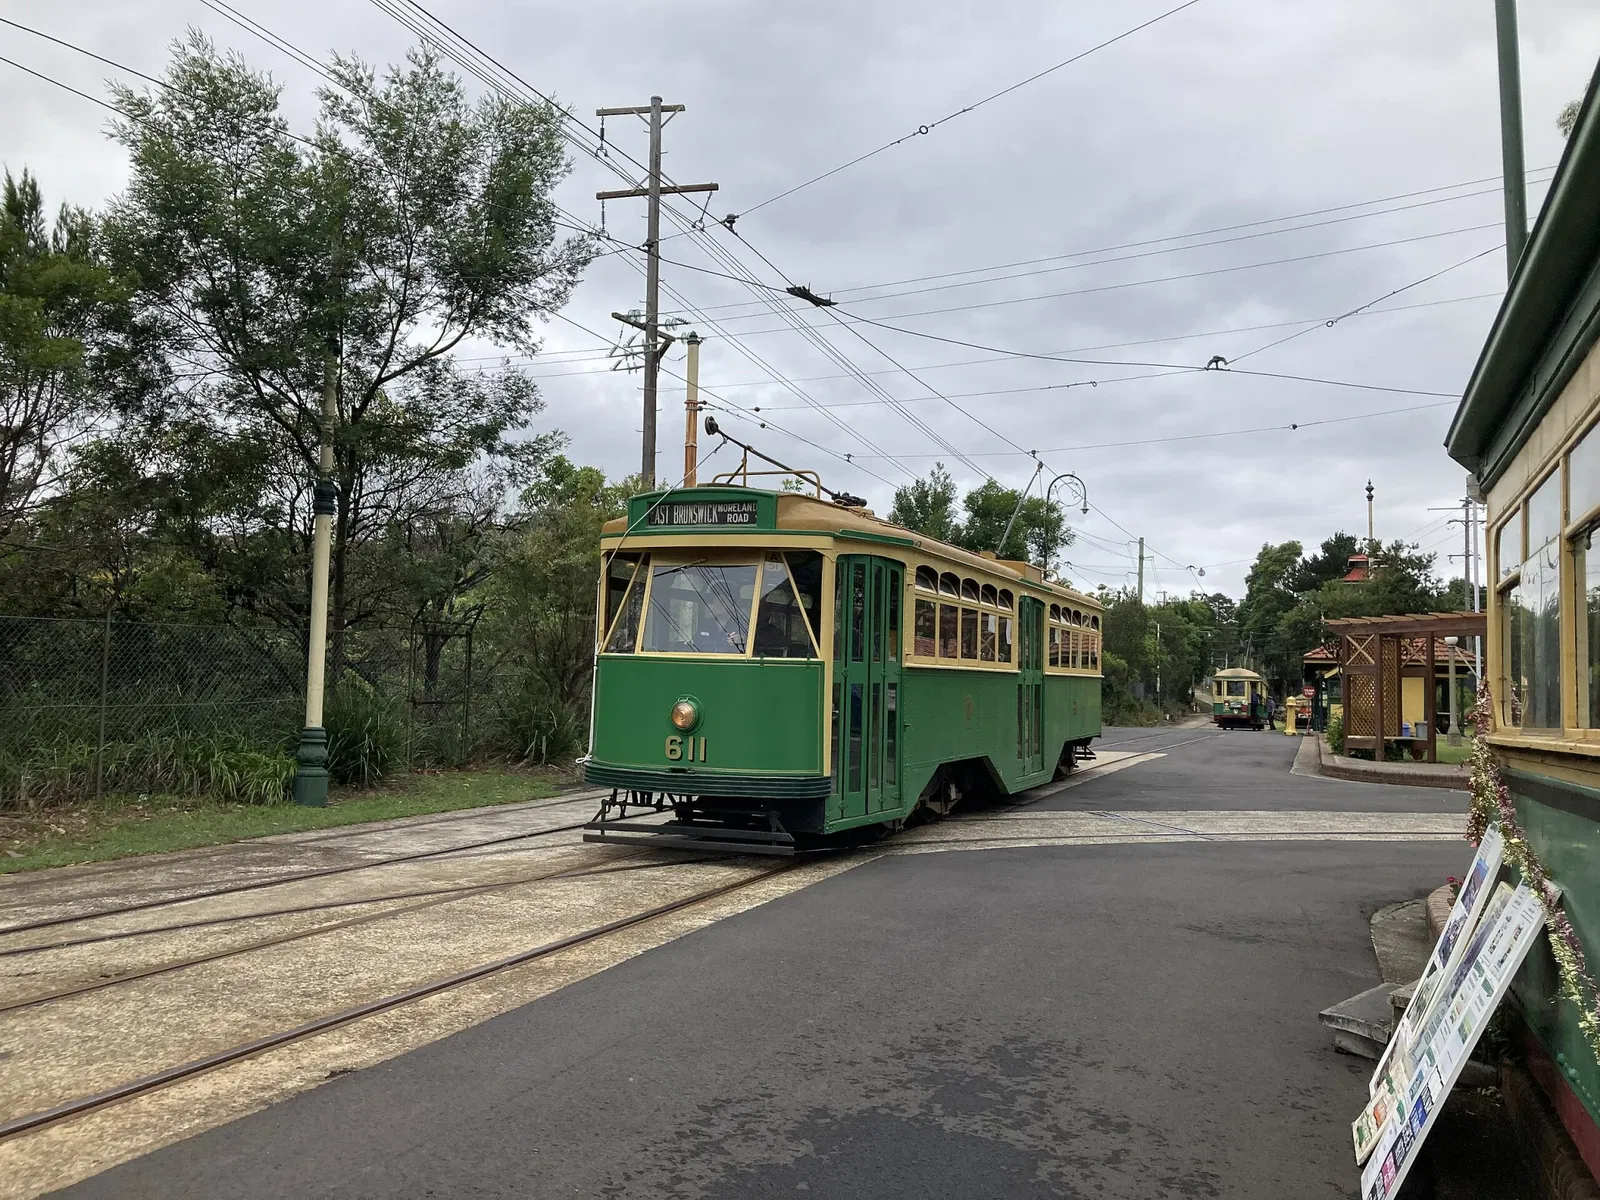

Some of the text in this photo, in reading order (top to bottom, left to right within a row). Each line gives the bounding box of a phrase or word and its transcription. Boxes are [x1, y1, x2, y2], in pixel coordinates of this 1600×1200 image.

[650, 503, 718, 525] AST BRUNSWICK
[717, 502, 757, 512] MORELAND
[726, 513, 749, 523] ROAD
[665, 735, 707, 762] 611
